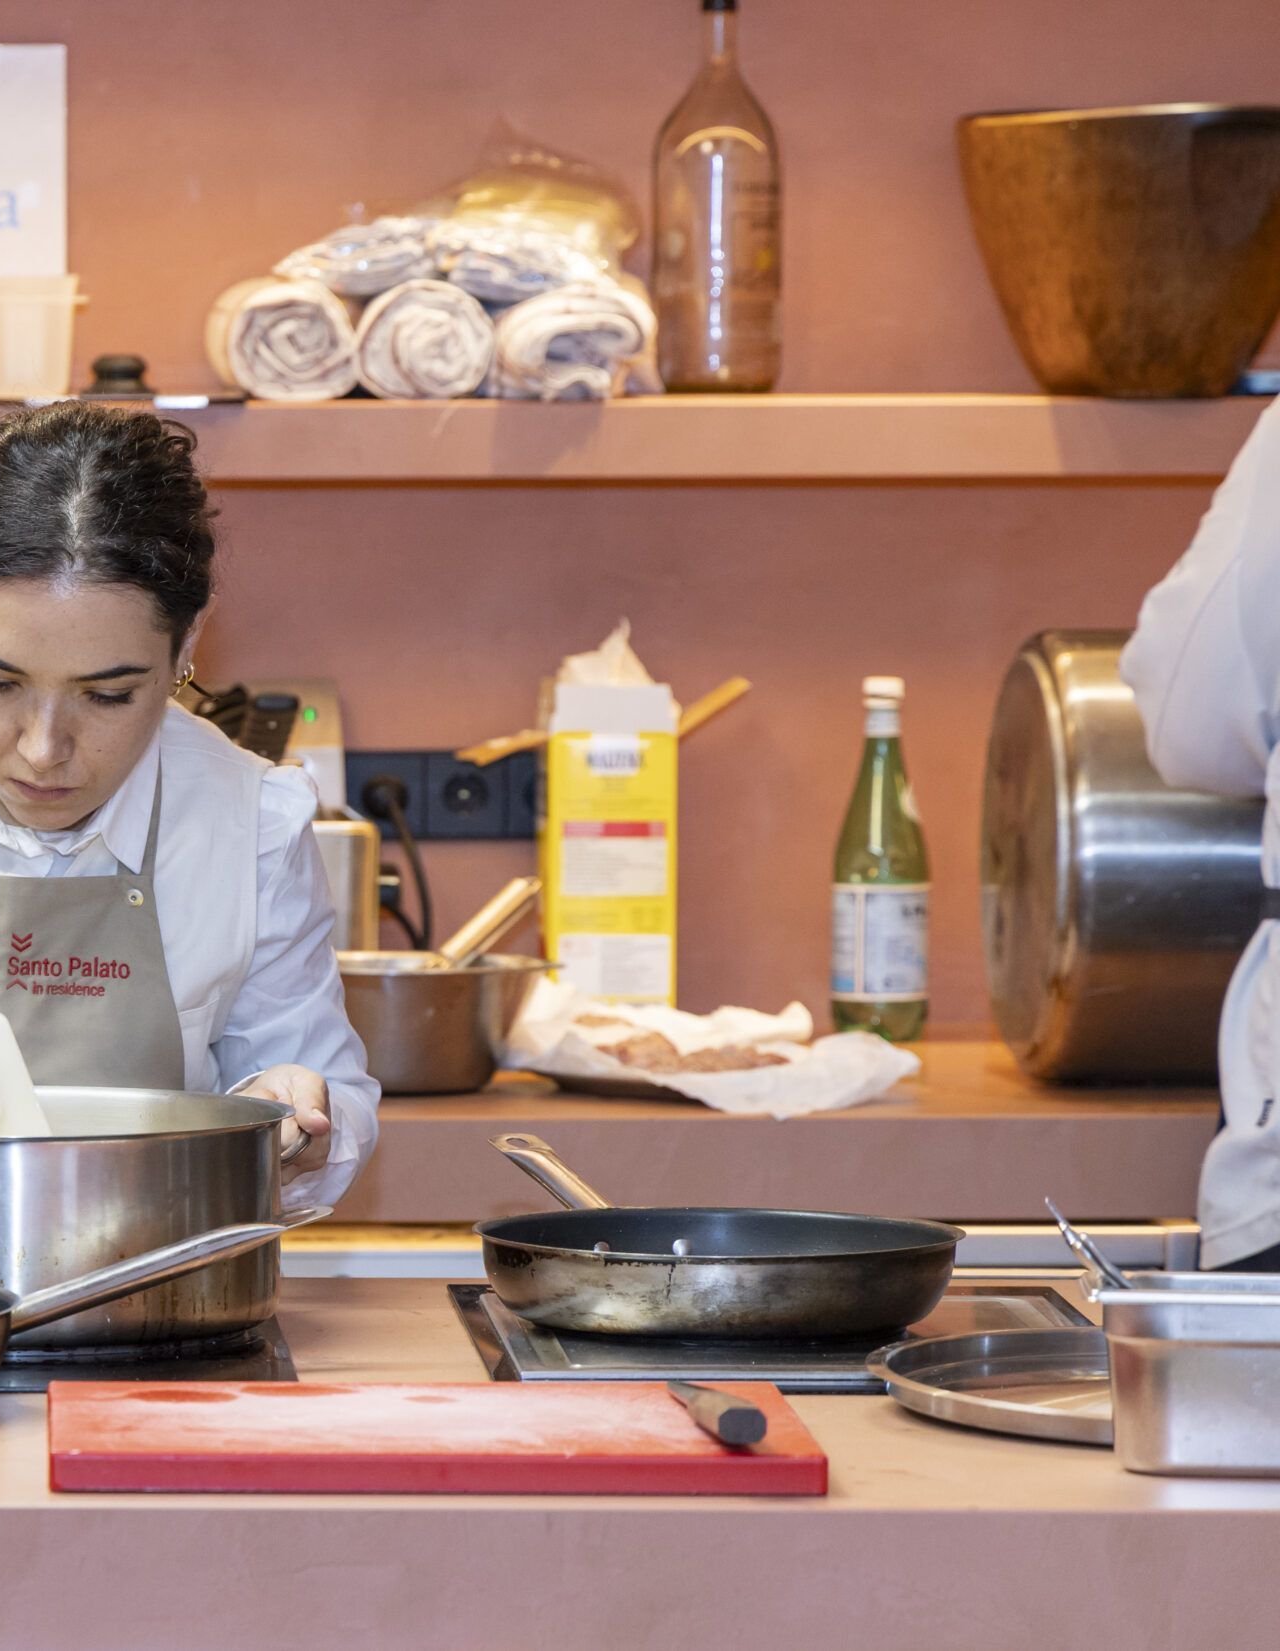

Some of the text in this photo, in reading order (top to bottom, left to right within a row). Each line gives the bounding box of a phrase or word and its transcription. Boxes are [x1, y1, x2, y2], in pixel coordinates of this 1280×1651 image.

[7, 956, 131, 979] Santo Palato
[31, 981, 106, 997] in residence
